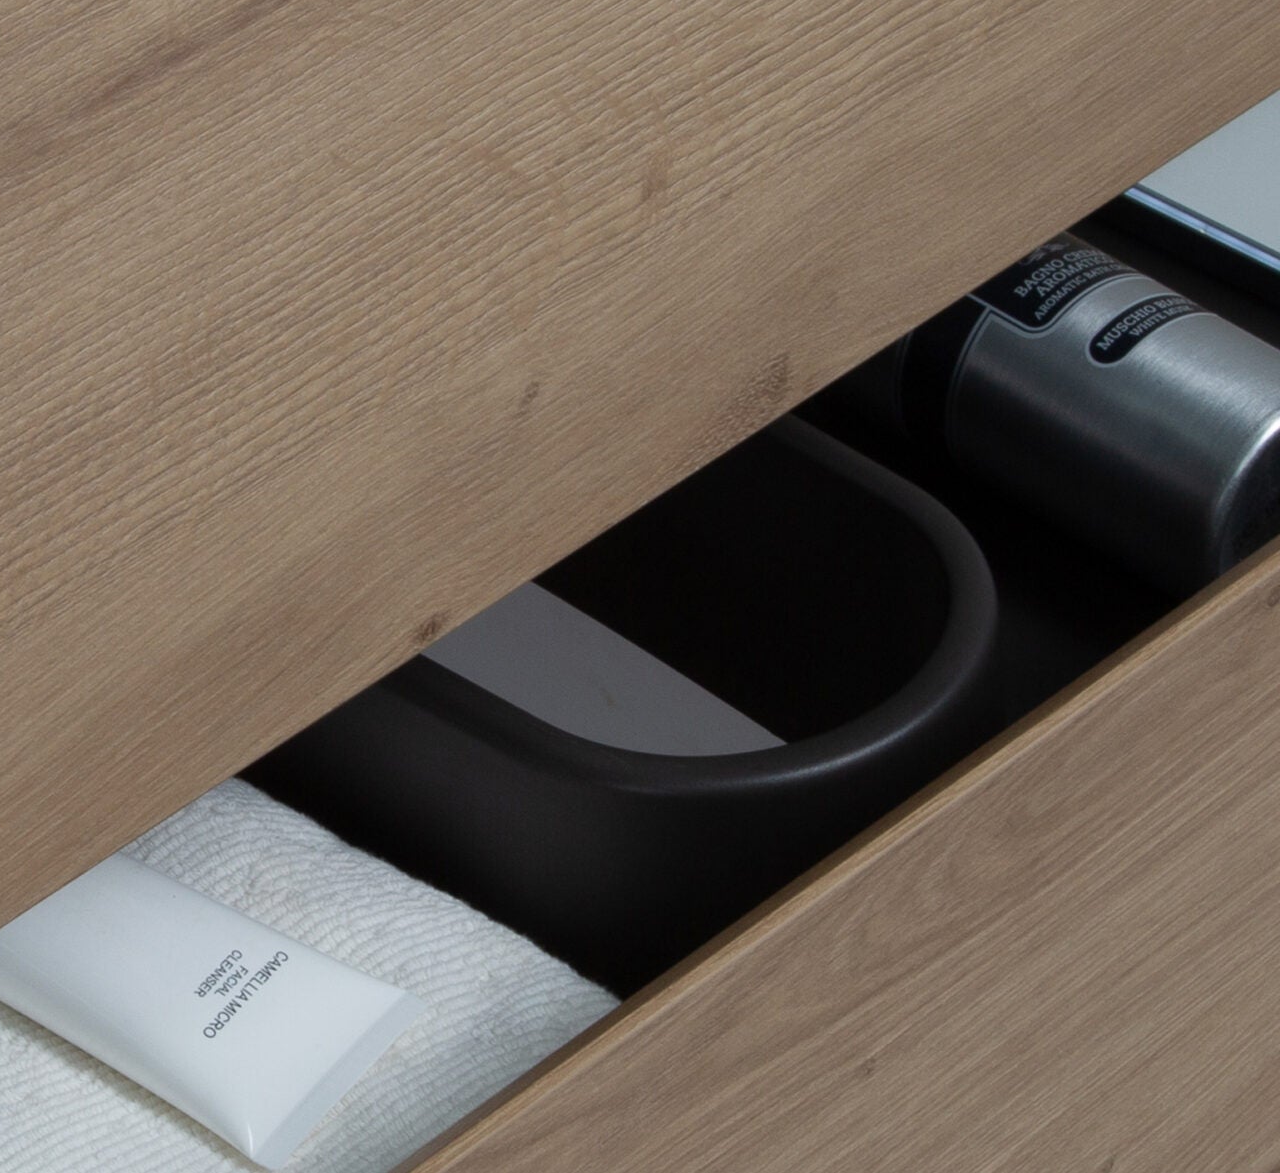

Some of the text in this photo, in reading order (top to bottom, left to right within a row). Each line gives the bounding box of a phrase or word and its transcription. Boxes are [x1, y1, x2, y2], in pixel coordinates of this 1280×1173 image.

[1014, 259, 1065, 298] BAGNO
[1034, 275, 1087, 321] AROMATIC
[1096, 304, 1157, 351] MUSCHIO
[193, 949, 244, 998] CLEANSER
[202, 950, 290, 1039] CAMELLIA MICRO
[213, 965, 249, 997] FACIAL
